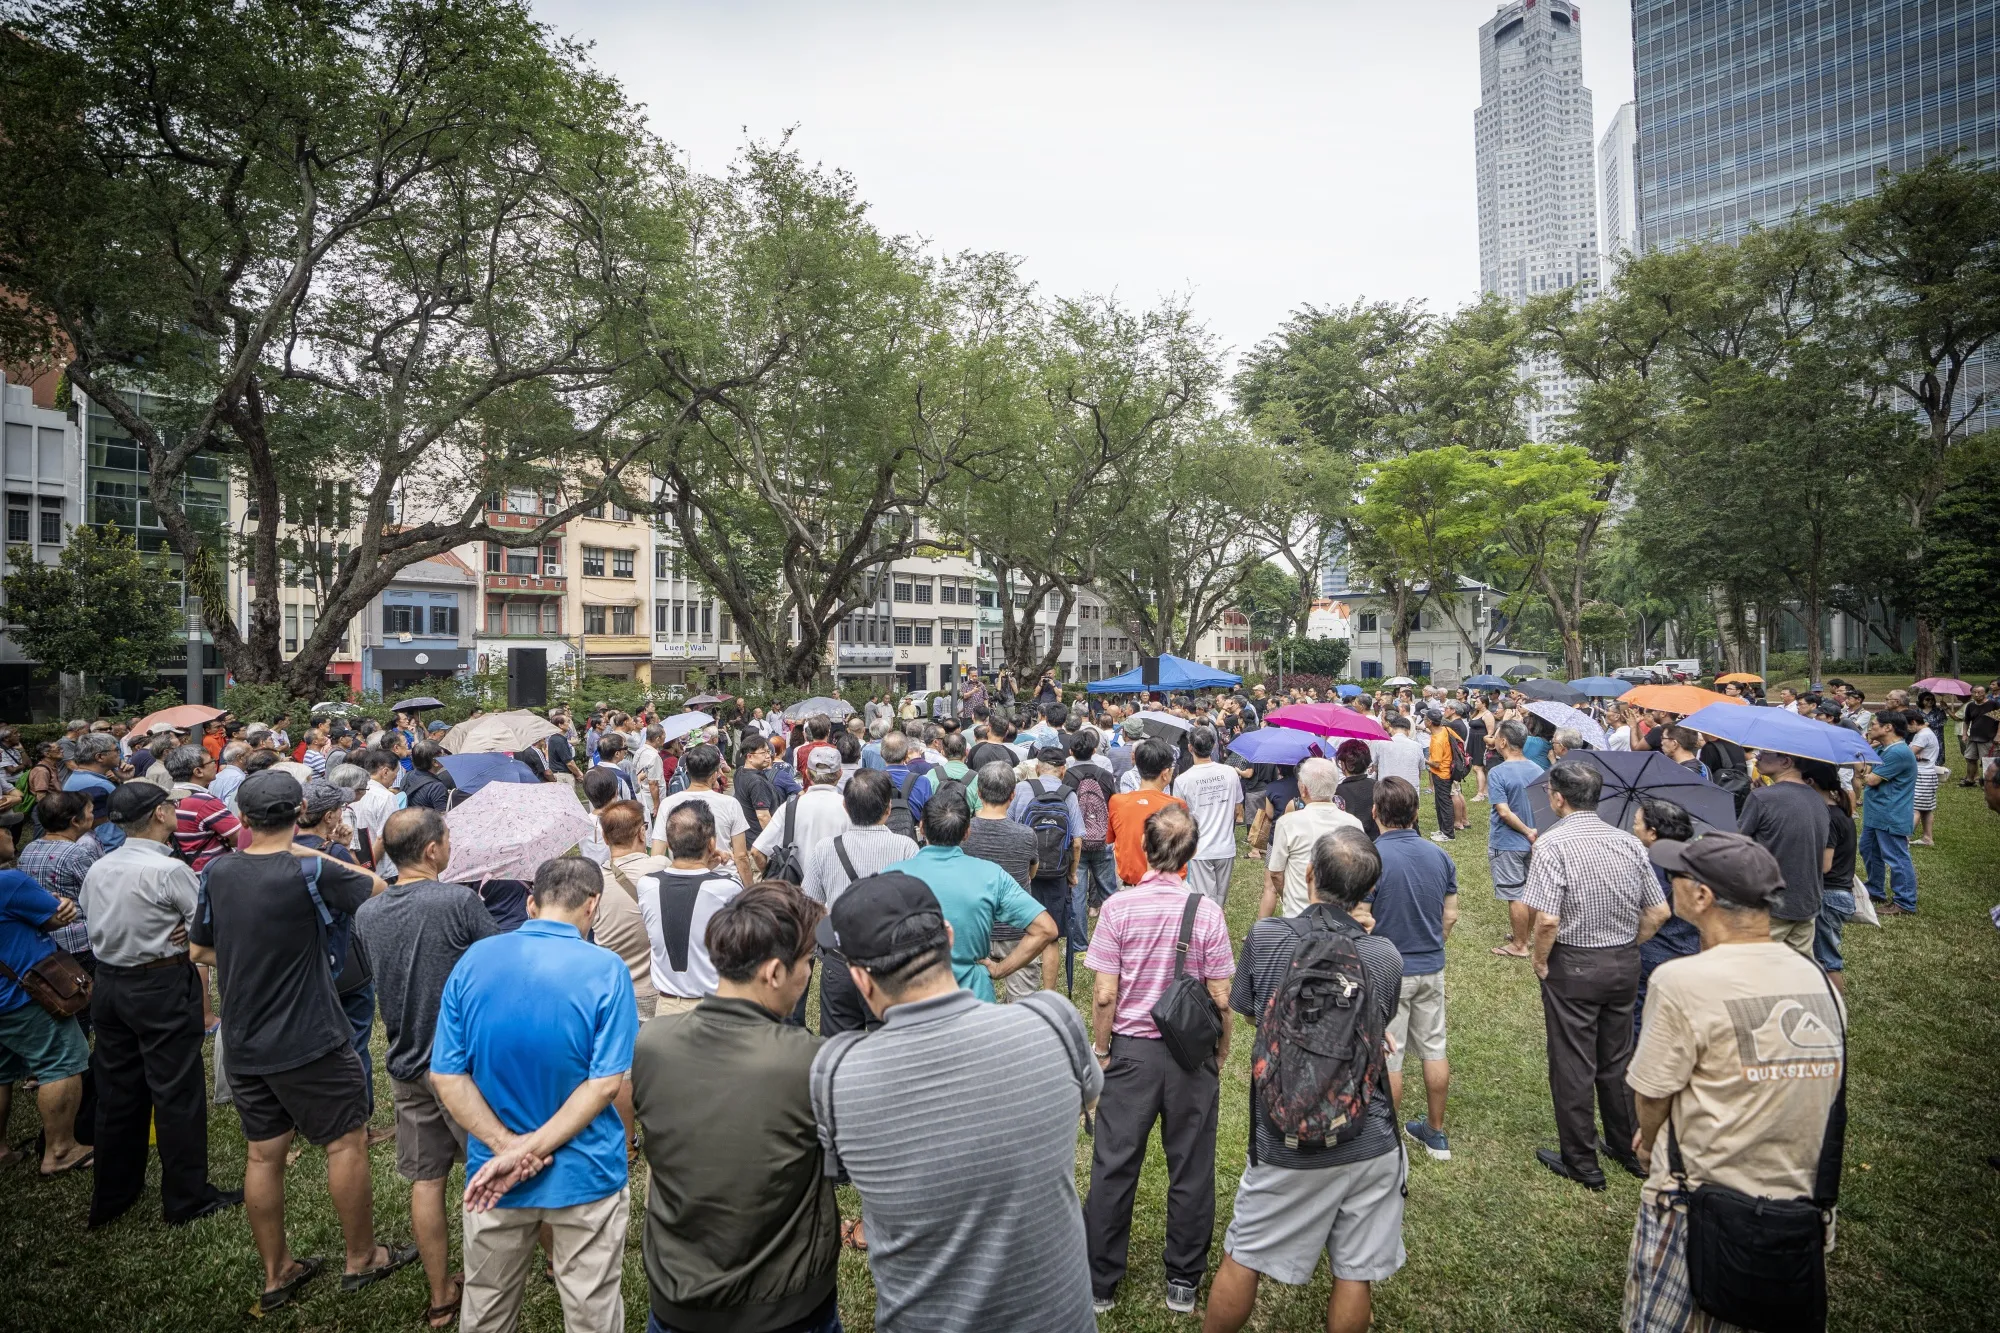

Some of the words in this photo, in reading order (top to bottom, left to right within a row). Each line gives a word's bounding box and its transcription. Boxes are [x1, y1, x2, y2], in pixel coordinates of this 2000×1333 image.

[664, 643, 685, 651] Luen
[690, 643, 707, 652] Wah
[900, 649, 909, 659] 35
[1195, 774, 1226, 786] FINISHER
[1746, 1063, 1836, 1082] QUIKSILVER
